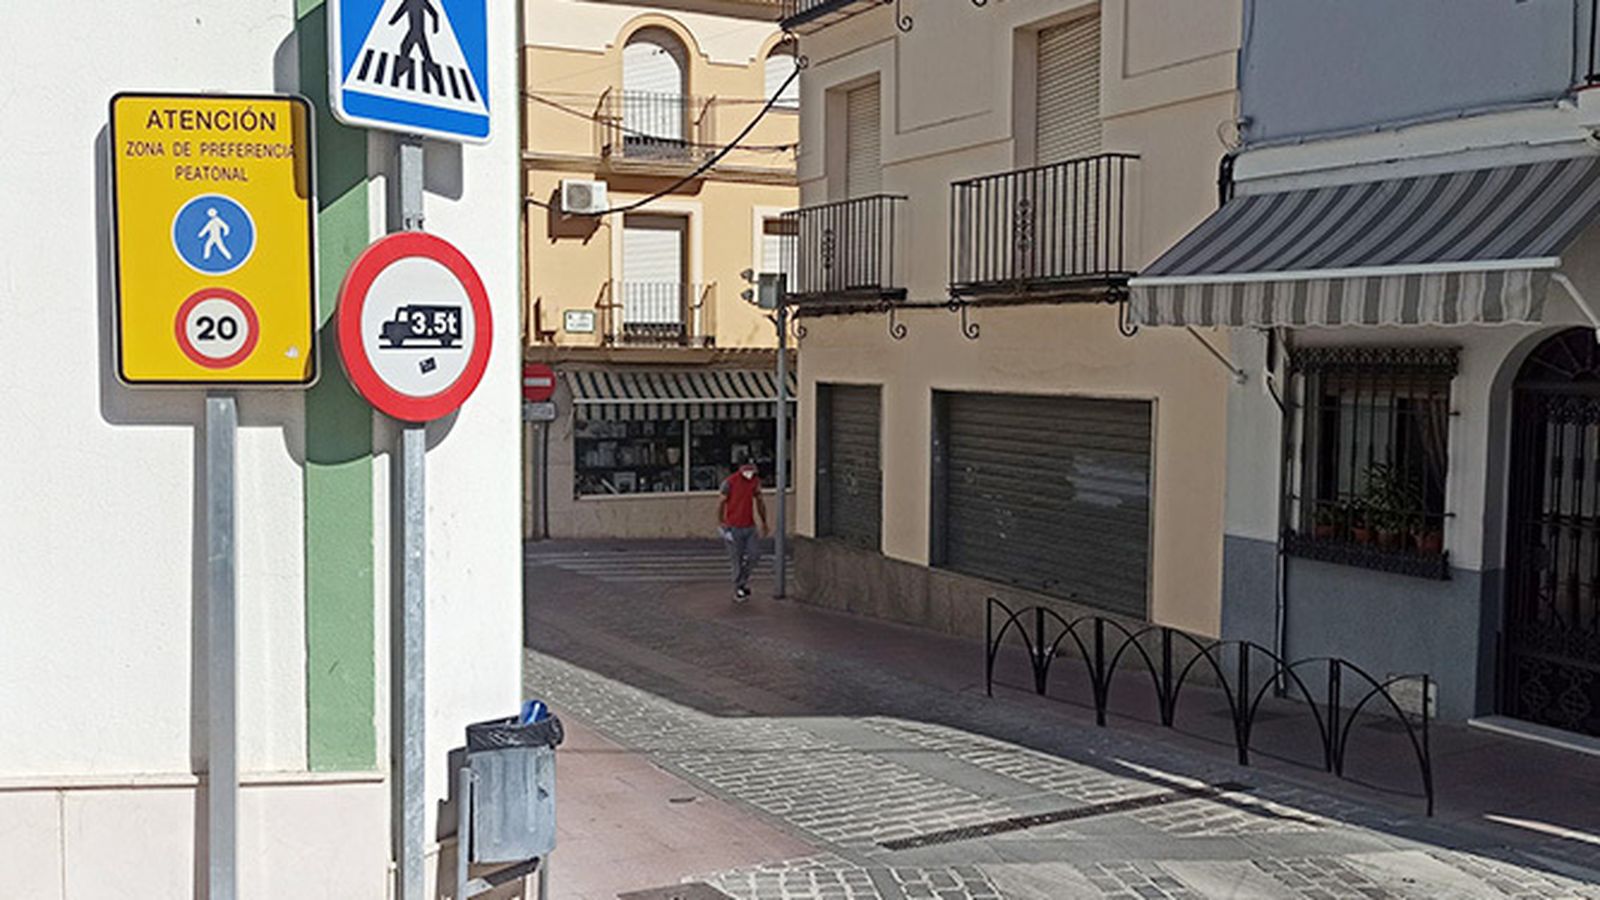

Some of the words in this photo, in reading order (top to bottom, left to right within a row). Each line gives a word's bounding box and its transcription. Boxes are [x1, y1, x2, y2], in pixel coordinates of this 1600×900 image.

[146, 106, 277, 131] ATENCIÓN
[126, 141, 165, 157] ZONA
[173, 142, 191, 157] DE
[200, 143, 297, 159] PREFERENCIA
[175, 165, 249, 182] PEATONAL
[196, 316, 238, 340] 20
